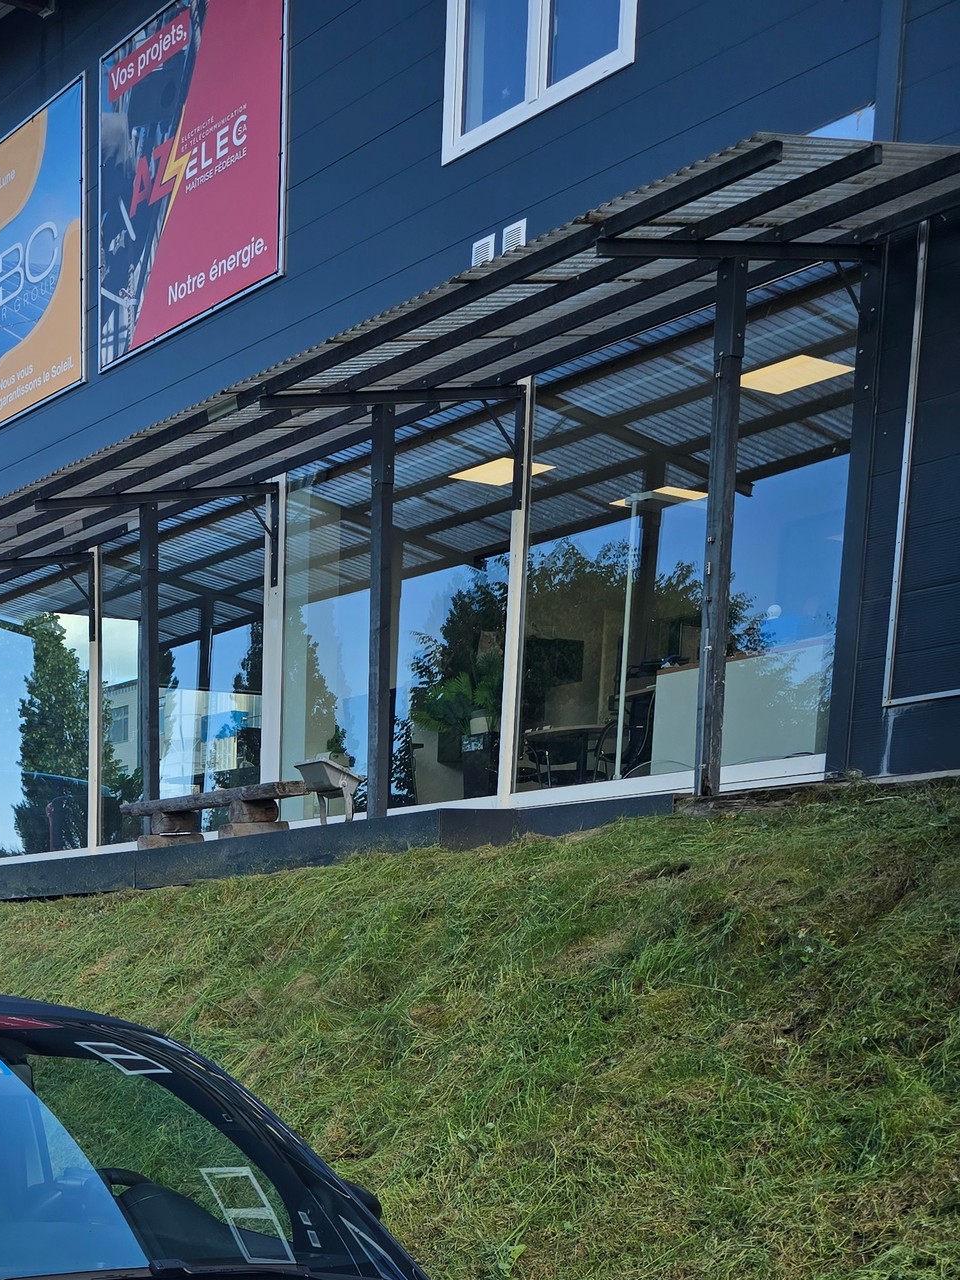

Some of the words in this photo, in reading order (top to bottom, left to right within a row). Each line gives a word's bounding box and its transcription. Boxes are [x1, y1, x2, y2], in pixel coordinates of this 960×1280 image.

[111, 62, 134, 91] Vos
[137, 23, 187, 76] projets,
[237, 123, 247, 136] SA
[214, 146, 247, 175] FÉDÉRALE
[168, 272, 206, 306] Notre
[209, 237, 268, 282] énergie.
[14, 276, 55, 312] GROUP
[16, 363, 33, 381] vous
[42, 371, 50, 384] le
[51, 356, 74, 378] Soleil.
